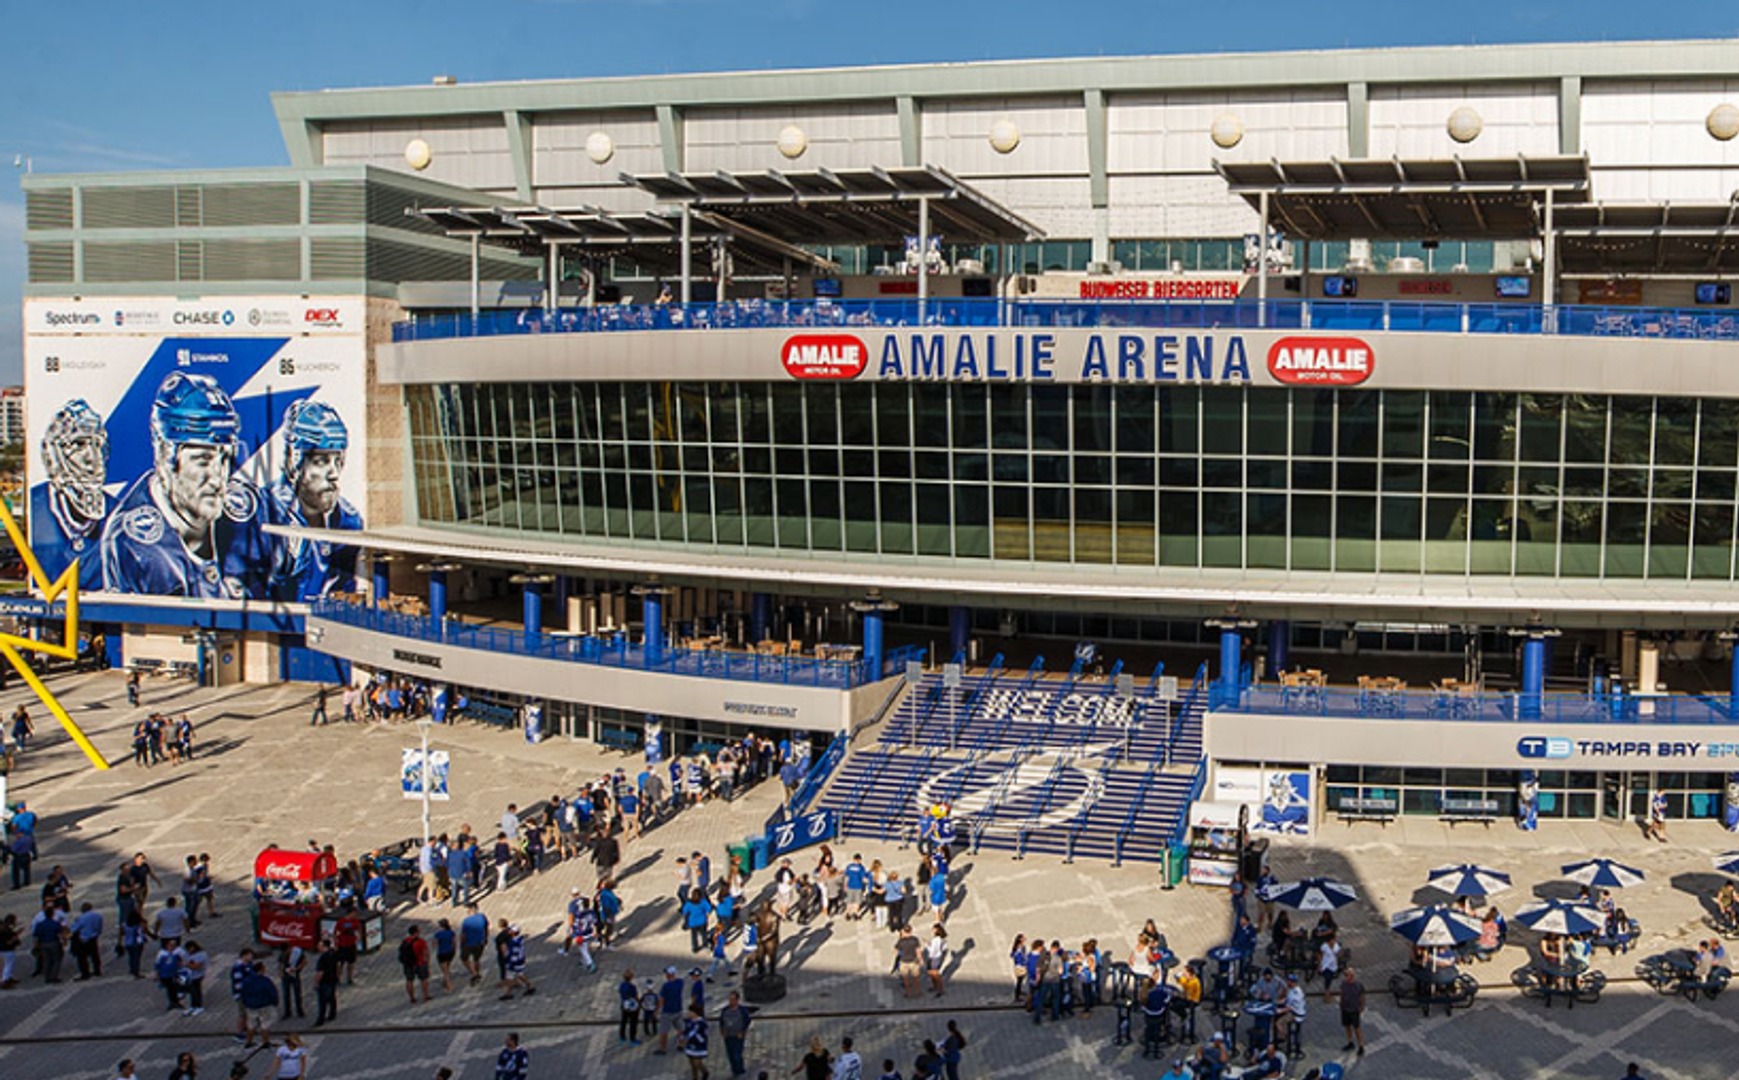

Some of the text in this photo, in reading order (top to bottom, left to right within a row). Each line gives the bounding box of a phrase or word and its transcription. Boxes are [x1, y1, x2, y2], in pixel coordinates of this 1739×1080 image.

[1080, 281, 1148, 299] BUDWEISER
[45, 311, 98, 326] Spectrum
[173, 311, 220, 325] CHASE
[304, 309, 340, 322] DEX
[786, 344, 861, 368] AMALIE
[878, 334, 1251, 381] AMALIE ARENA
[1275, 347, 1369, 373] AMALIE
[1577, 741, 1651, 757] TAMPA
[1656, 741, 1701, 757] BAY
